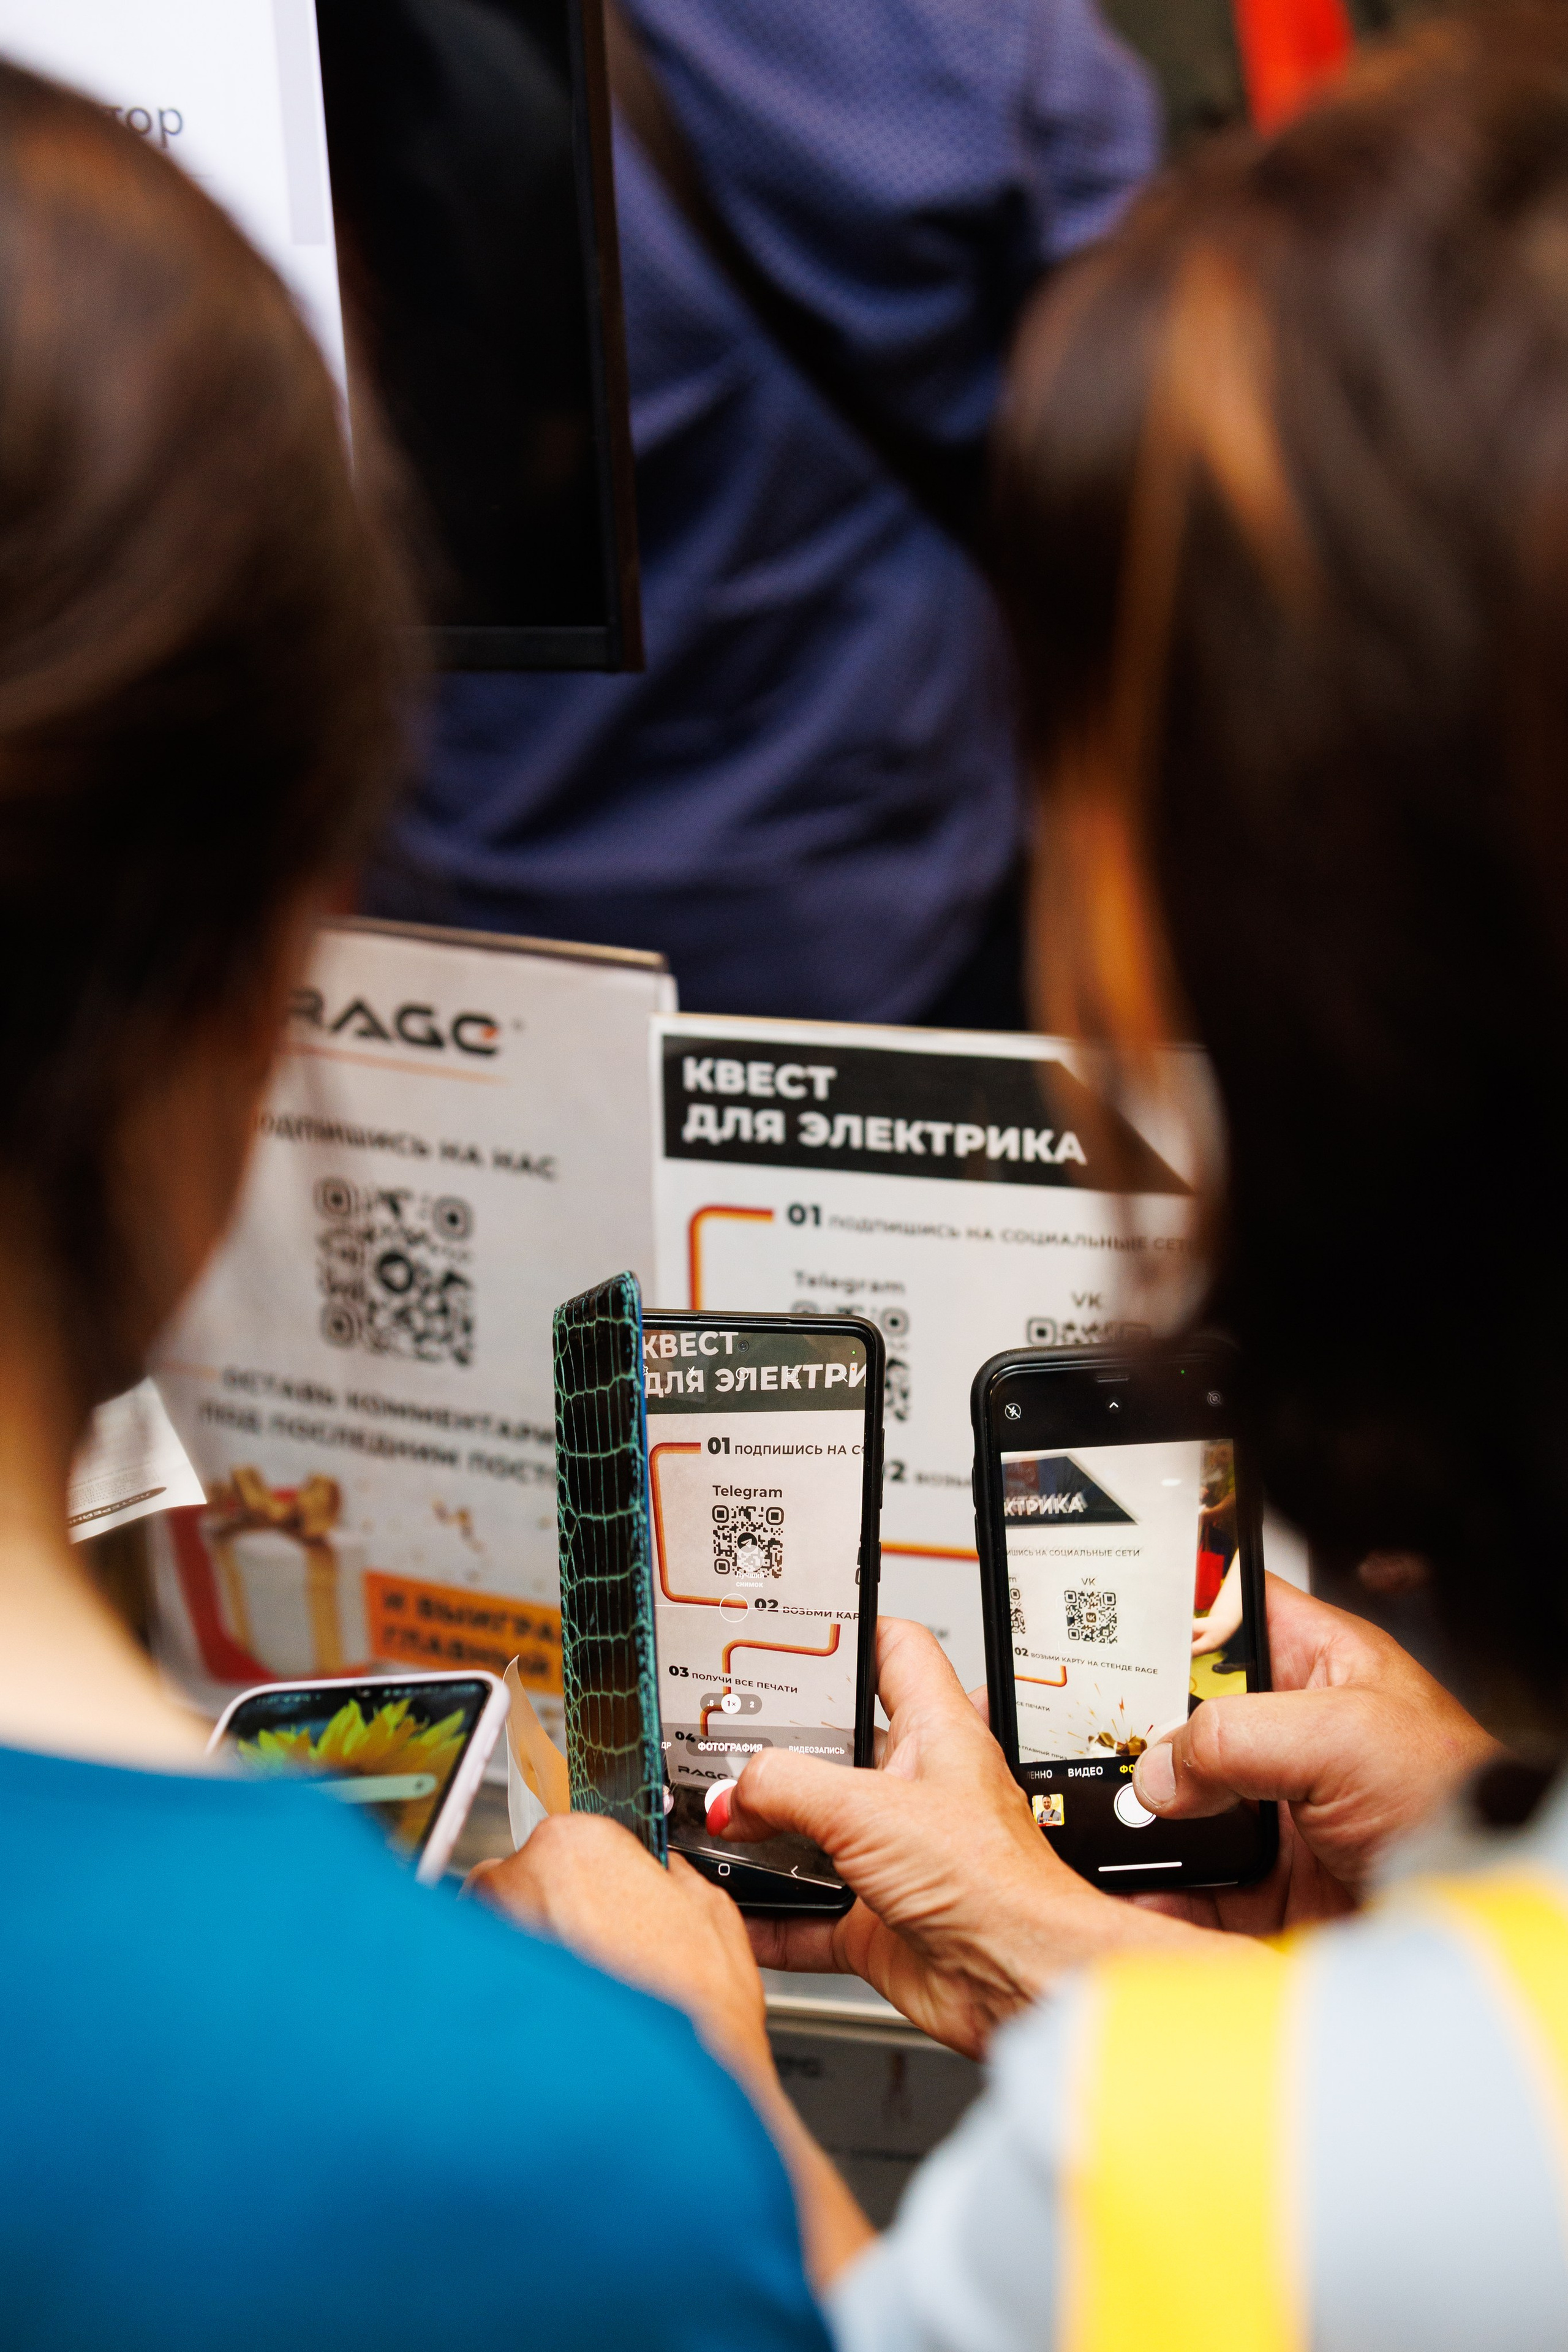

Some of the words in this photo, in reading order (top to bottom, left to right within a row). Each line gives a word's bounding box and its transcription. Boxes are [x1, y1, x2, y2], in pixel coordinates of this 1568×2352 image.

[682, 1055, 837, 1101] КВЕСТ
[682, 1103, 786, 1145] ДЛЯ
[797, 1110, 1088, 1166] ЭЛЕКТРИКА
[787, 1203, 823, 1226] 01
[829, 1212, 959, 1238] ПОДПИШИСЬ
[967, 1226, 995, 1242] НА
[1002, 1227, 1148, 1253] СОЦИАЛЬНЫЕ
[794, 1270, 906, 1296] Telegram
[1071, 1292, 1103, 1309] VK
[643, 1331, 739, 1359] КВЕСТ
[644, 1369, 704, 1398] ДЛЯ
[707, 1436, 730, 1455] 01
[734, 1445, 823, 1456] ПОДПИШИСЬ
[827, 1445, 847, 1455] НА
[712, 1485, 783, 1500] Telegram
[1050, 1549, 1112, 1558] СОЦИАЛЬНЫЕ
[1081, 1577, 1096, 1586] VK
[755, 1598, 778, 1613] 02
[783, 1606, 832, 1618] ВОЗЬМИ
[837, 1611, 859, 1620] КАР
[1014, 1647, 1029, 1657] 02
[1031, 1653, 1060, 1662] ВОЗЬМИ
[1061, 1657, 1085, 1665] КАРТУ
[1101, 1662, 1133, 1672] СТЕНДЕ
[1135, 1666, 1158, 1675] RAGE
[668, 1665, 690, 1677] 03
[692, 1673, 732, 1684] ПОЛУЧИ
[757, 1682, 798, 1694] ПЕЧАТИ
[1025, 1703, 1050, 1712] ПЕЧАТИ
[675, 1731, 696, 1743] 04
[698, 1741, 763, 1753] ФОТОГРАФИЯ
[788, 1745, 845, 1755] ВИДЕОЗАПИСЬ
[1068, 1766, 1104, 1777] ВИДЕО
